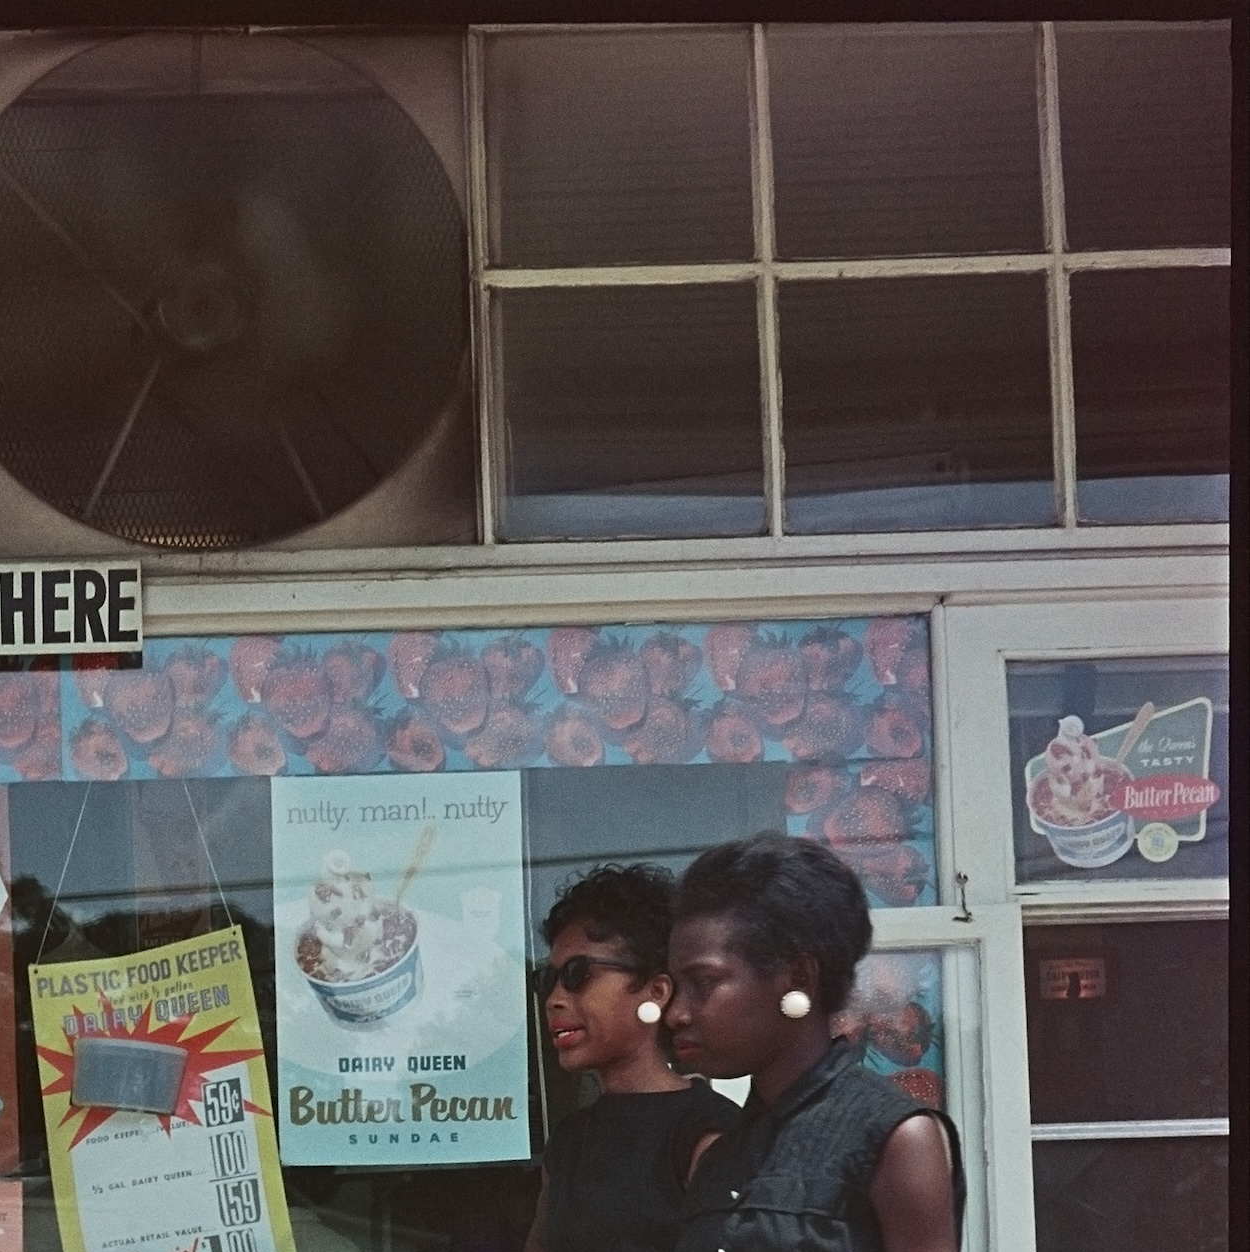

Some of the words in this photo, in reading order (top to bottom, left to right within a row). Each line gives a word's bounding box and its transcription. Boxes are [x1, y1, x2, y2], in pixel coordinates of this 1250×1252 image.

[0, 569, 138, 645] HERE
[1140, 755, 1194, 768] TASTY
[444, 794, 508, 824] nutty
[1124, 786, 1172, 810] Butter
[1173, 782, 1215, 805] Pecan
[37, 970, 121, 998] PLASTIC
[126, 957, 171, 988] FOOD
[176, 940, 242, 976] KEEPER
[63, 1003, 143, 1036] DAIRY
[155, 984, 231, 1022] QUEEN
[338, 1056, 395, 1073] DAIRY
[407, 1055, 466, 1073] QUEEN
[205, 1081, 240, 1126] 59¢
[288, 1085, 404, 1126] Butter
[409, 1083, 517, 1123] Pecan
[86, 1135, 110, 1145] FOOD
[114, 1130, 143, 1140] KEEPE
[350, 1132, 459, 1144] SUNDAE
[132, 1176, 158, 1187] DAIRY
[164, 1170, 192, 1181] QUEEN
[102, 1237, 136, 1249] ACTUAL
[140, 1232, 170, 1242] RETAIL
[175, 1226, 203, 1237] VALUE
